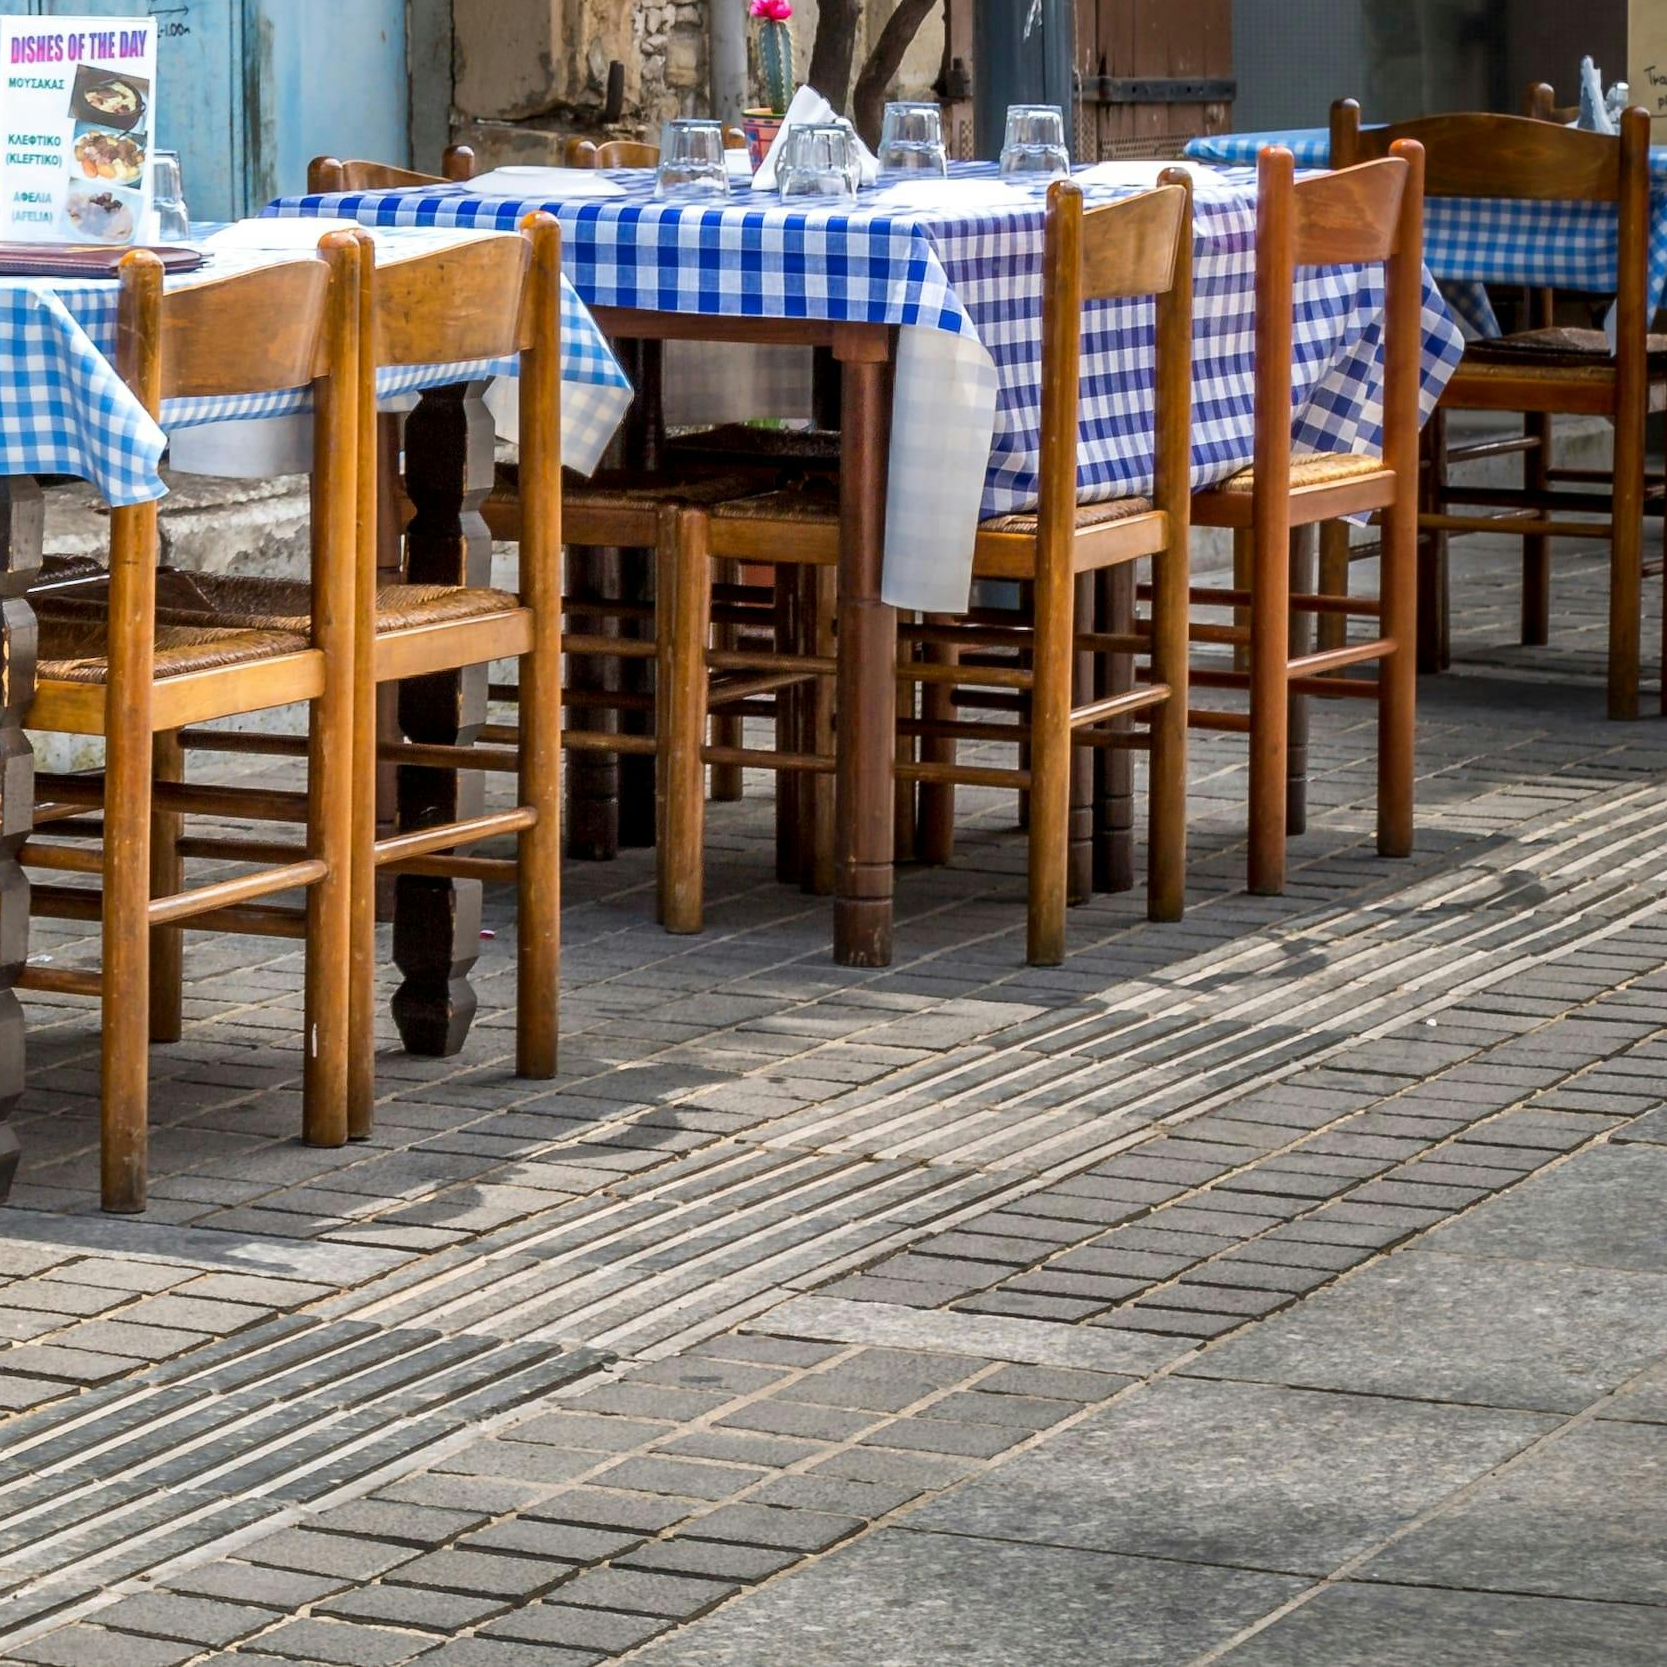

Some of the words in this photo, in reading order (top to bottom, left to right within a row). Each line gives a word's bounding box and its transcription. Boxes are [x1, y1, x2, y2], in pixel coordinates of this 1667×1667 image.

[11, 34, 64, 64] DISHES
[68, 33, 86, 61] OF
[89, 31, 116, 60] THE
[119, 29, 147, 58] DAY
[8, 77, 65, 90] ΜΟΥΣΑΚΑΣ
[8, 134, 61, 147] ΚΛΕΦΤΙΚΟ
[6, 153, 63, 168] (KLEFTIKO)
[12, 210, 54, 224] (AFELIA)
